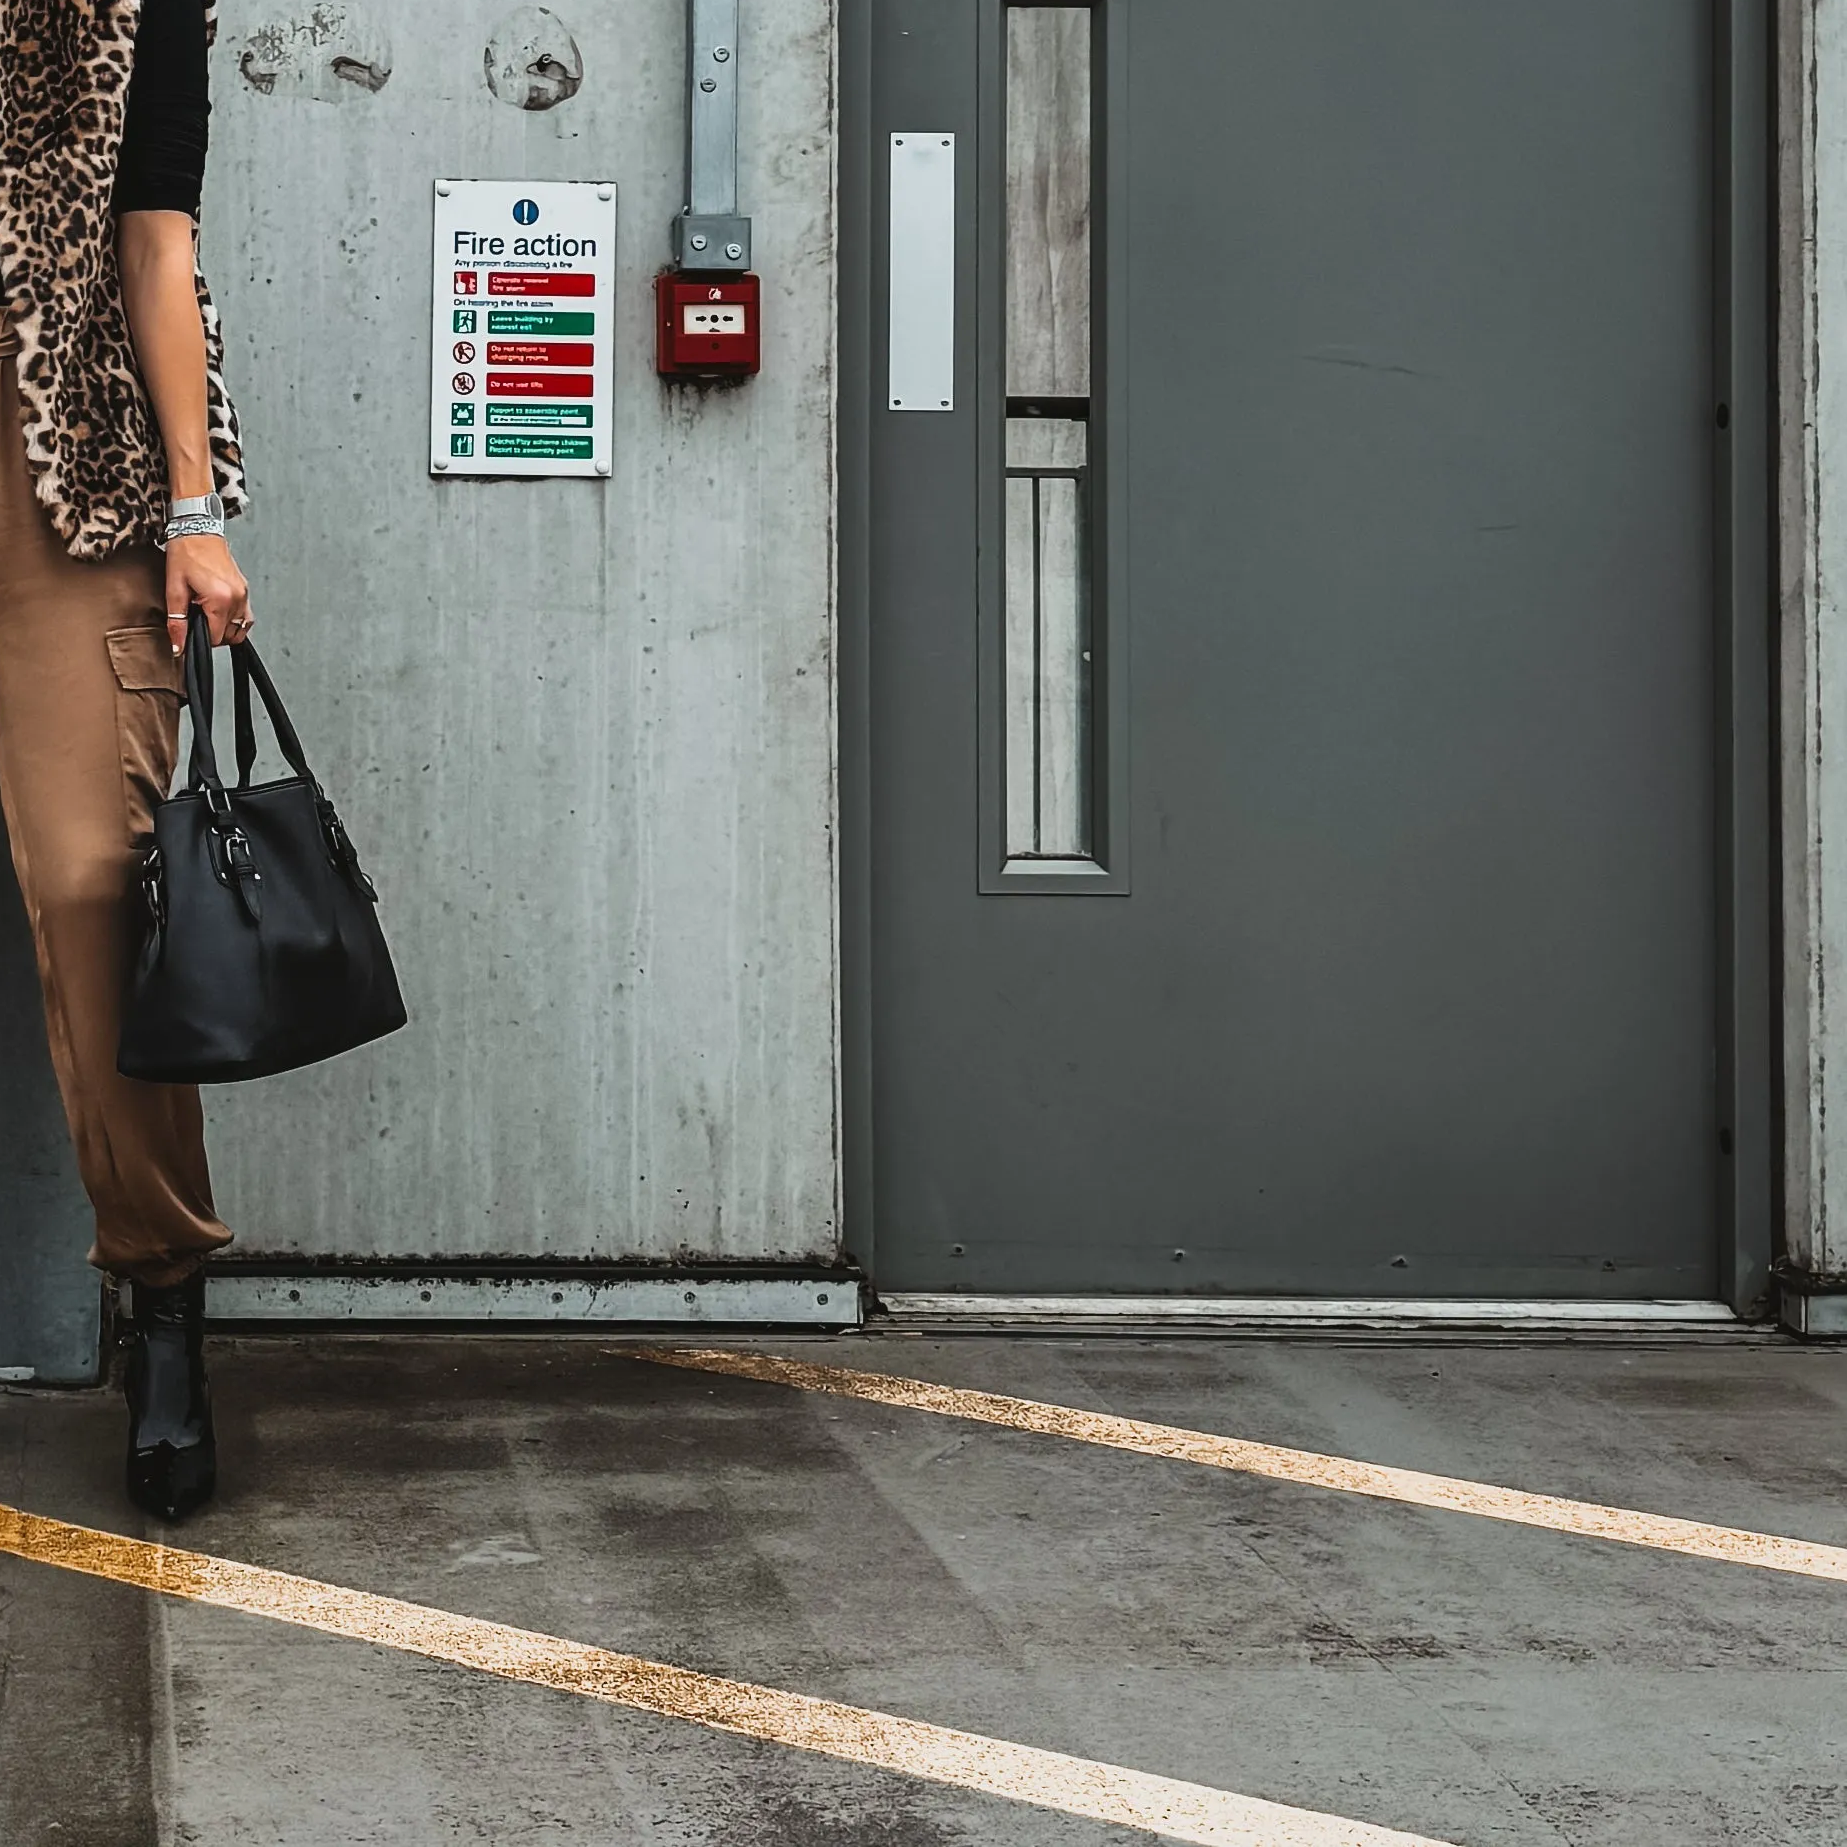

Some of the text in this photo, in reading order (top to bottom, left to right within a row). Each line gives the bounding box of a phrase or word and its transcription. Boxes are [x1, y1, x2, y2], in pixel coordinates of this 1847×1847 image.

[454, 230, 596, 257] Fire action
[454, 259, 470, 268] Any
[473, 260, 501, 268] person
[503, 260, 550, 269] discovering
[453, 299, 466, 307] On
[468, 299, 498, 308] hearing
[515, 316, 543, 324] building
[545, 316, 553, 324] by
